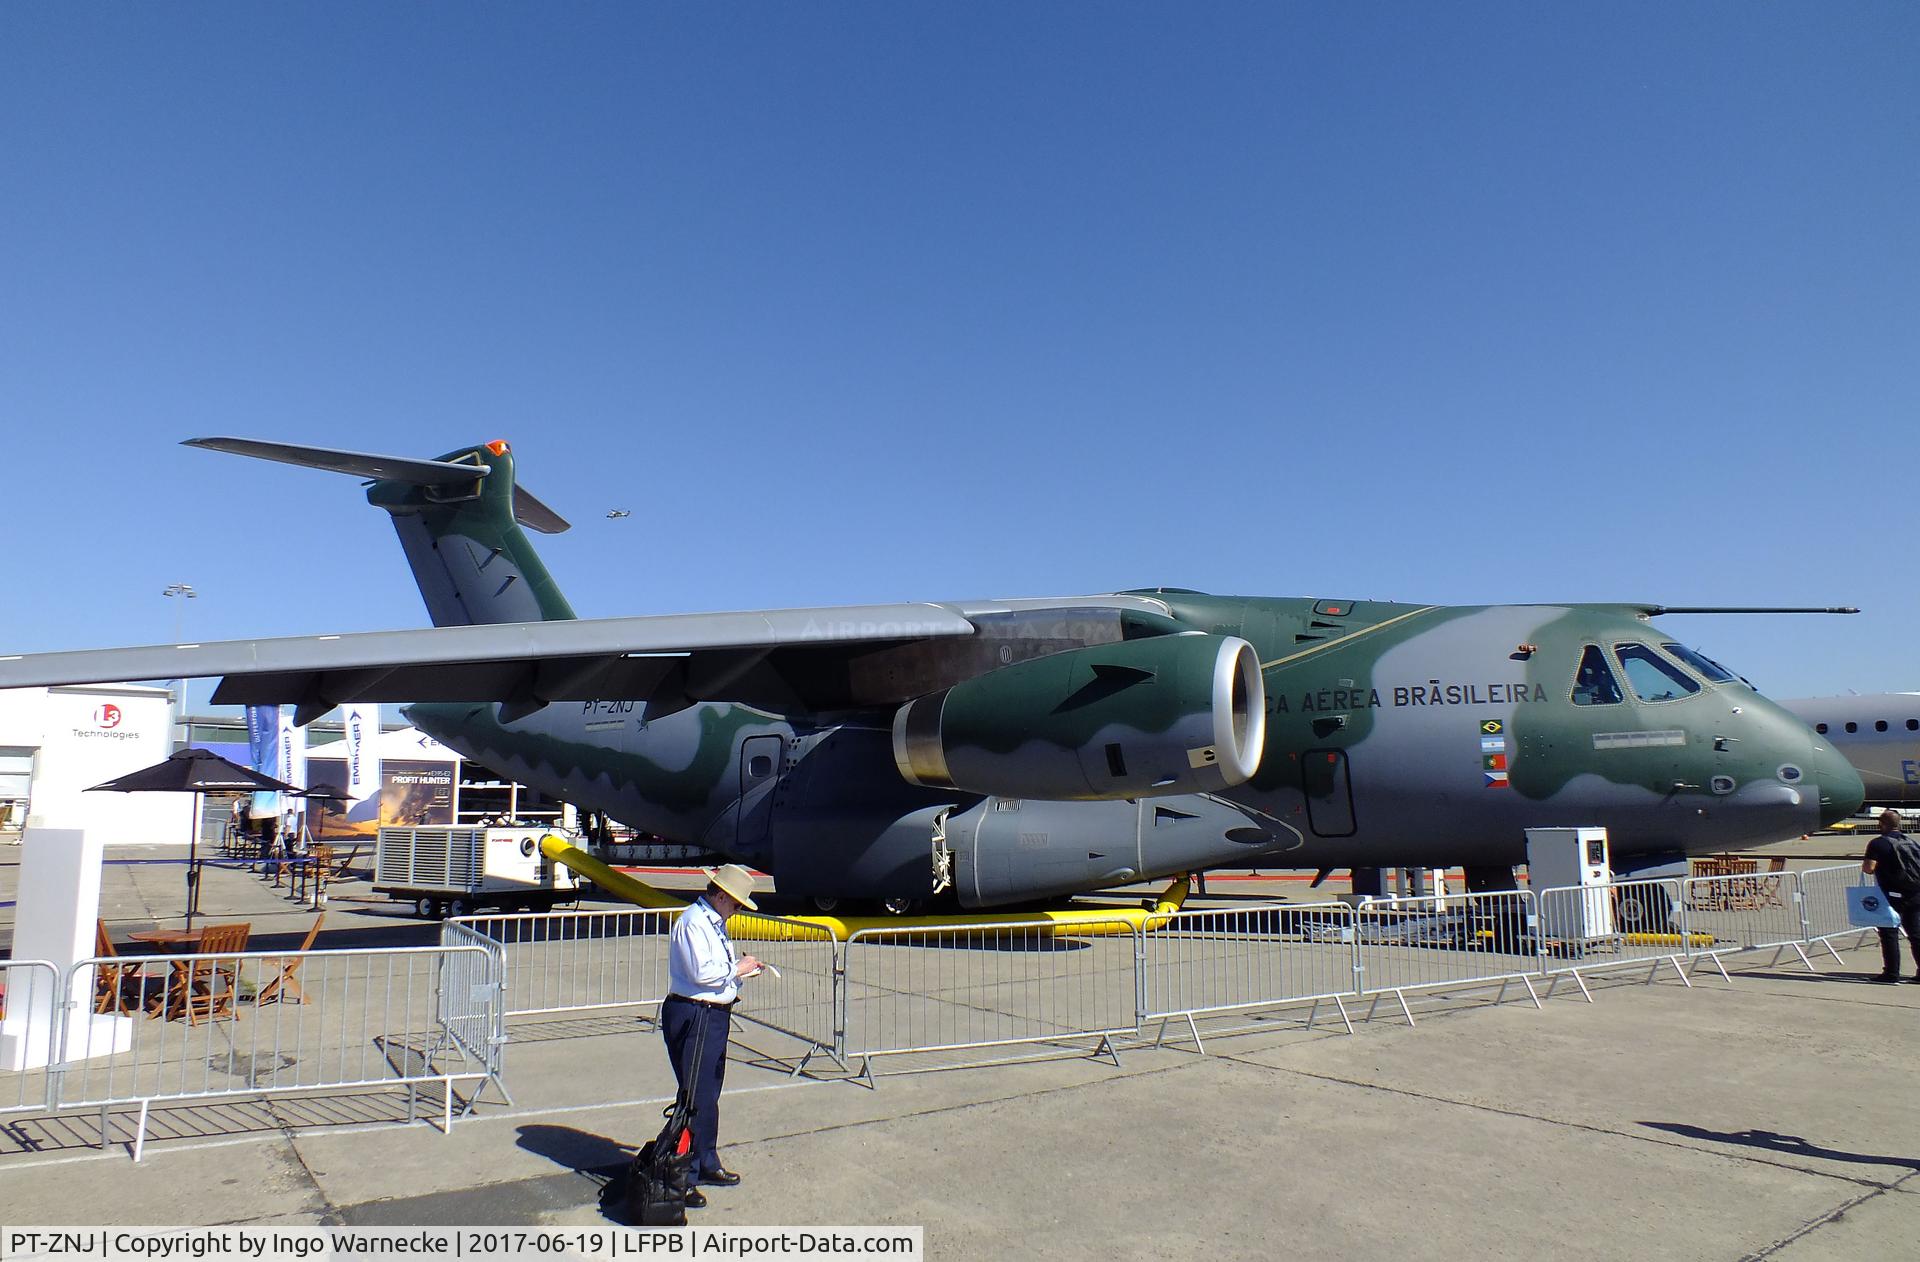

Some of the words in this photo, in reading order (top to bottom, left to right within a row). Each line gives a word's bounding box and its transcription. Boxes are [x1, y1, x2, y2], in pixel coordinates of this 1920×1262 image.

[72, 729, 140, 740] Technologies
[353, 724, 361, 785] EMBRAER
[391, 776, 419, 784] PROFIT
[420, 776, 451, 785] HUNTER
